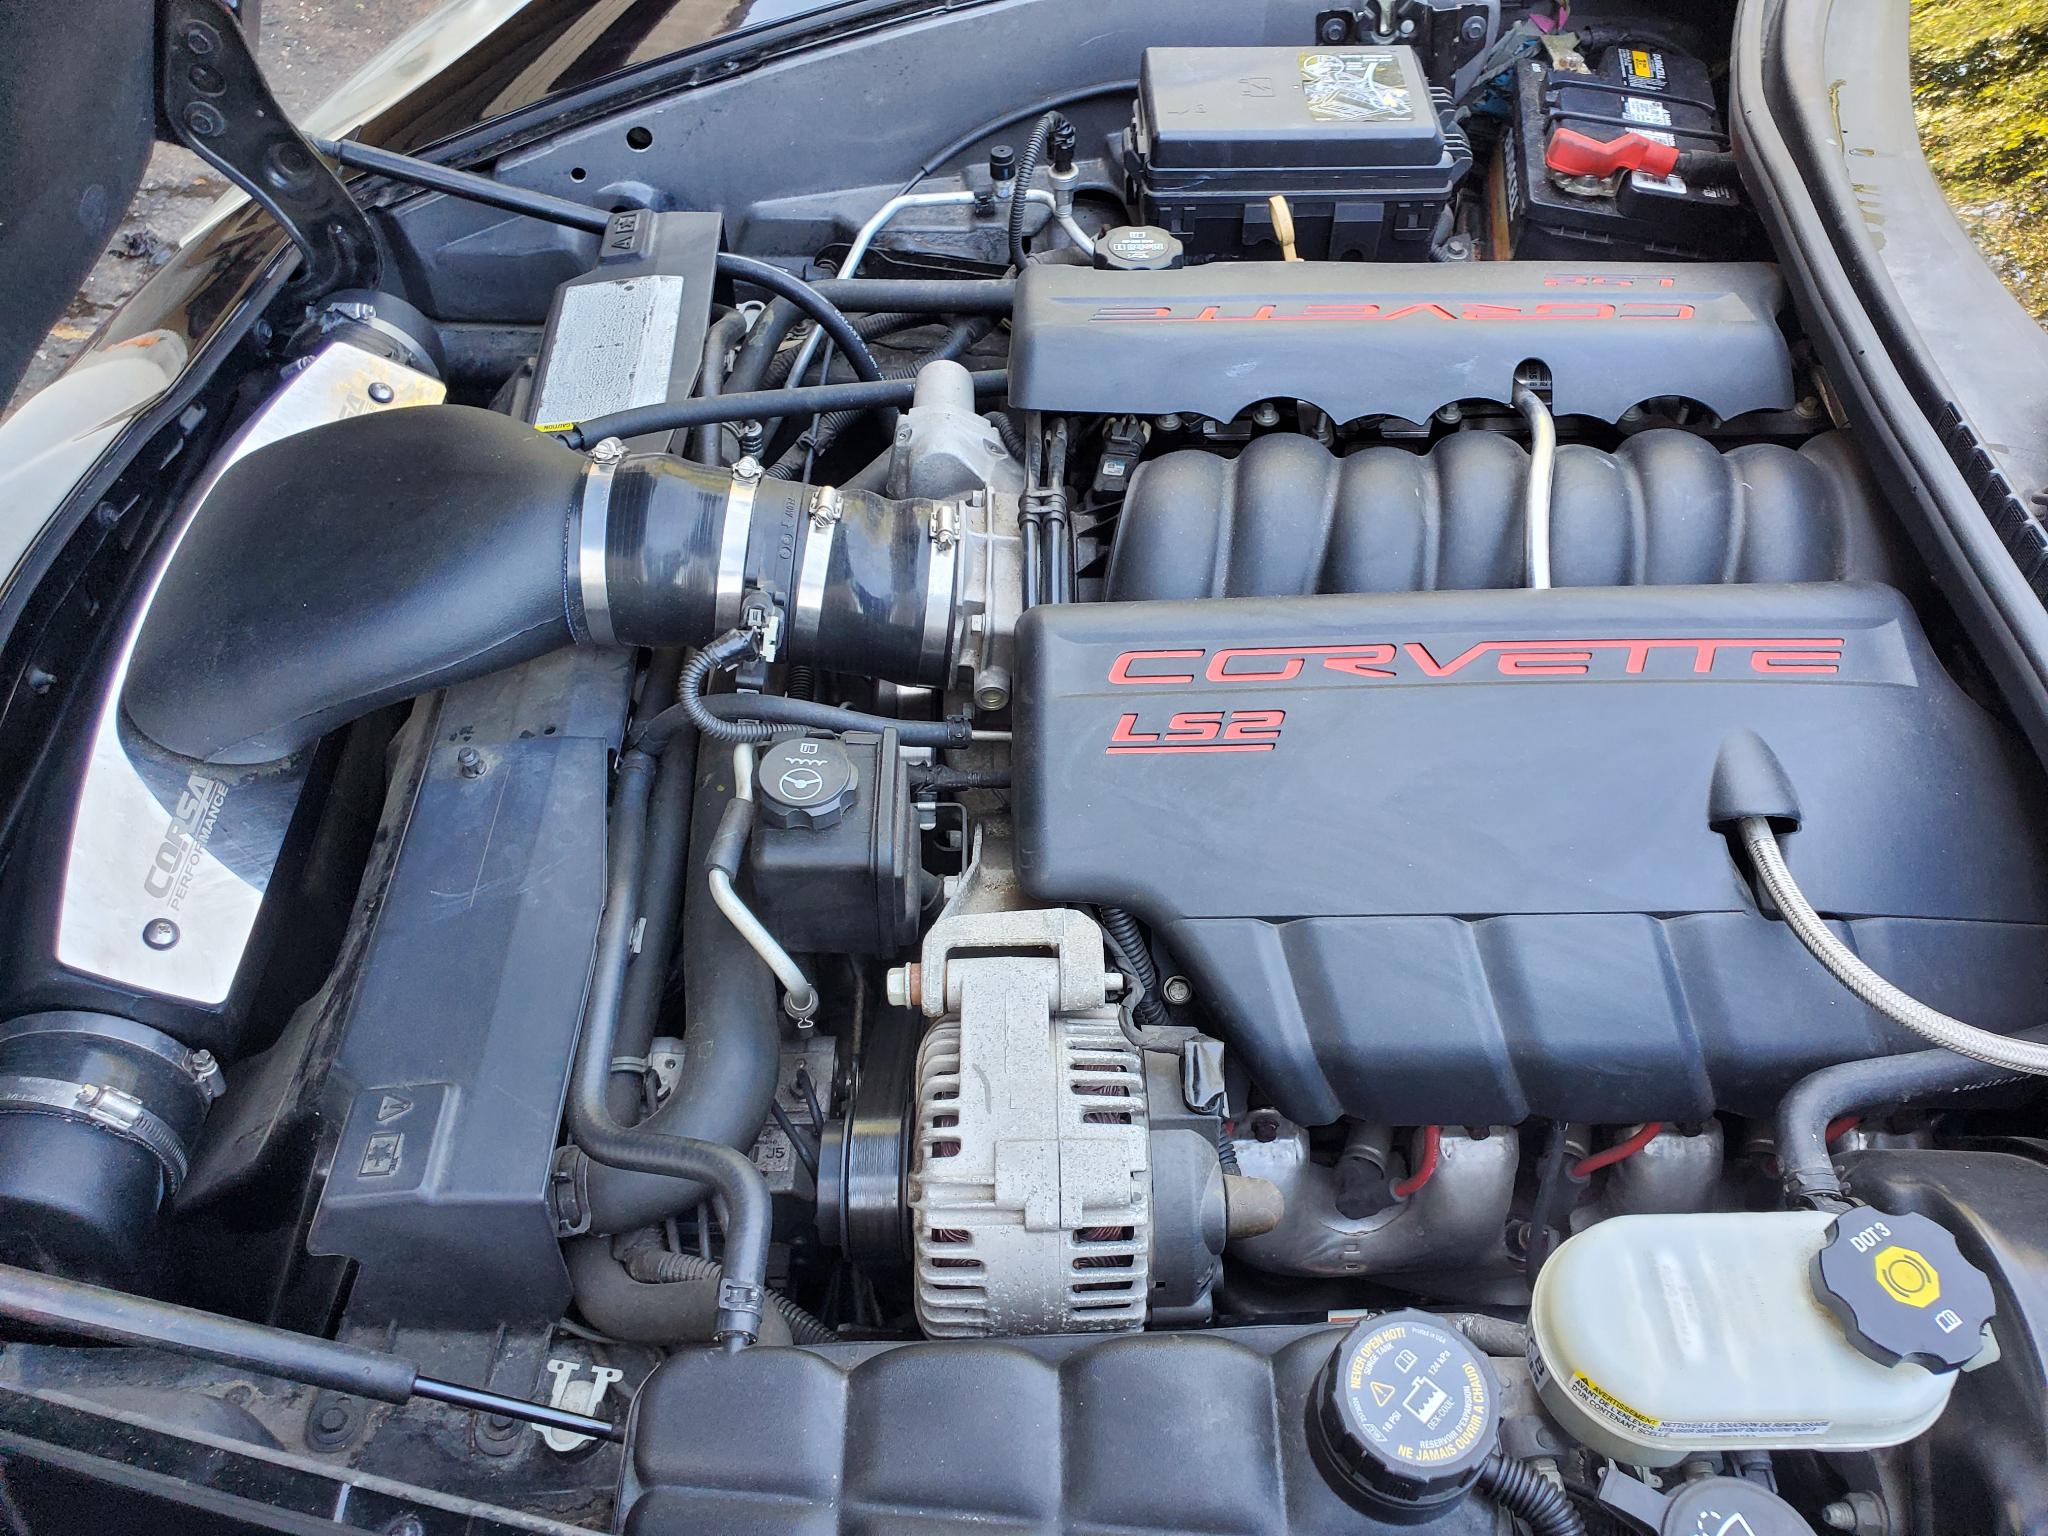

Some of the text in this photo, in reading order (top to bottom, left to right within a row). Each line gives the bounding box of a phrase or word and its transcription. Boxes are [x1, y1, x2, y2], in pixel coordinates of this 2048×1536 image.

[1088, 303, 1696, 321] CORVETTE
[544, 423, 571, 431] CAUTION
[1108, 637, 1844, 684] CORVETTE
[1112, 710, 1286, 742] LS2
[144, 774, 215, 899] CORSA
[170, 782, 229, 911] PERFORMANCE
[1849, 1222, 1891, 1253] DOT 3
[1351, 1355, 1366, 1388] NEVER
[1360, 1336, 1384, 1357] OPEN
[1381, 1327, 1406, 1343] HOT!
[1363, 1342, 1395, 1375] SURGE TANK
[1428, 1350, 1450, 1376] 124 kPa
[1462, 1362, 1484, 1403] CHAUD!
[1382, 1410, 1402, 1433] 18 PSI
[1456, 1385, 1472, 1432] D'EXPANSION
[1571, 1384, 1589, 1401] D'UN
[1589, 1399, 1636, 1431] CONTENANT
[1575, 1379, 1655, 1430] AVANT DE L'ENLEVER
[1593, 1386, 1658, 1425] AVERTISSEMENT
[1455, 1415, 1482, 1450] OUVRIR
[1398, 1444, 1414, 1459] NE
[1415, 1443, 1457, 1461] JAMAIS
